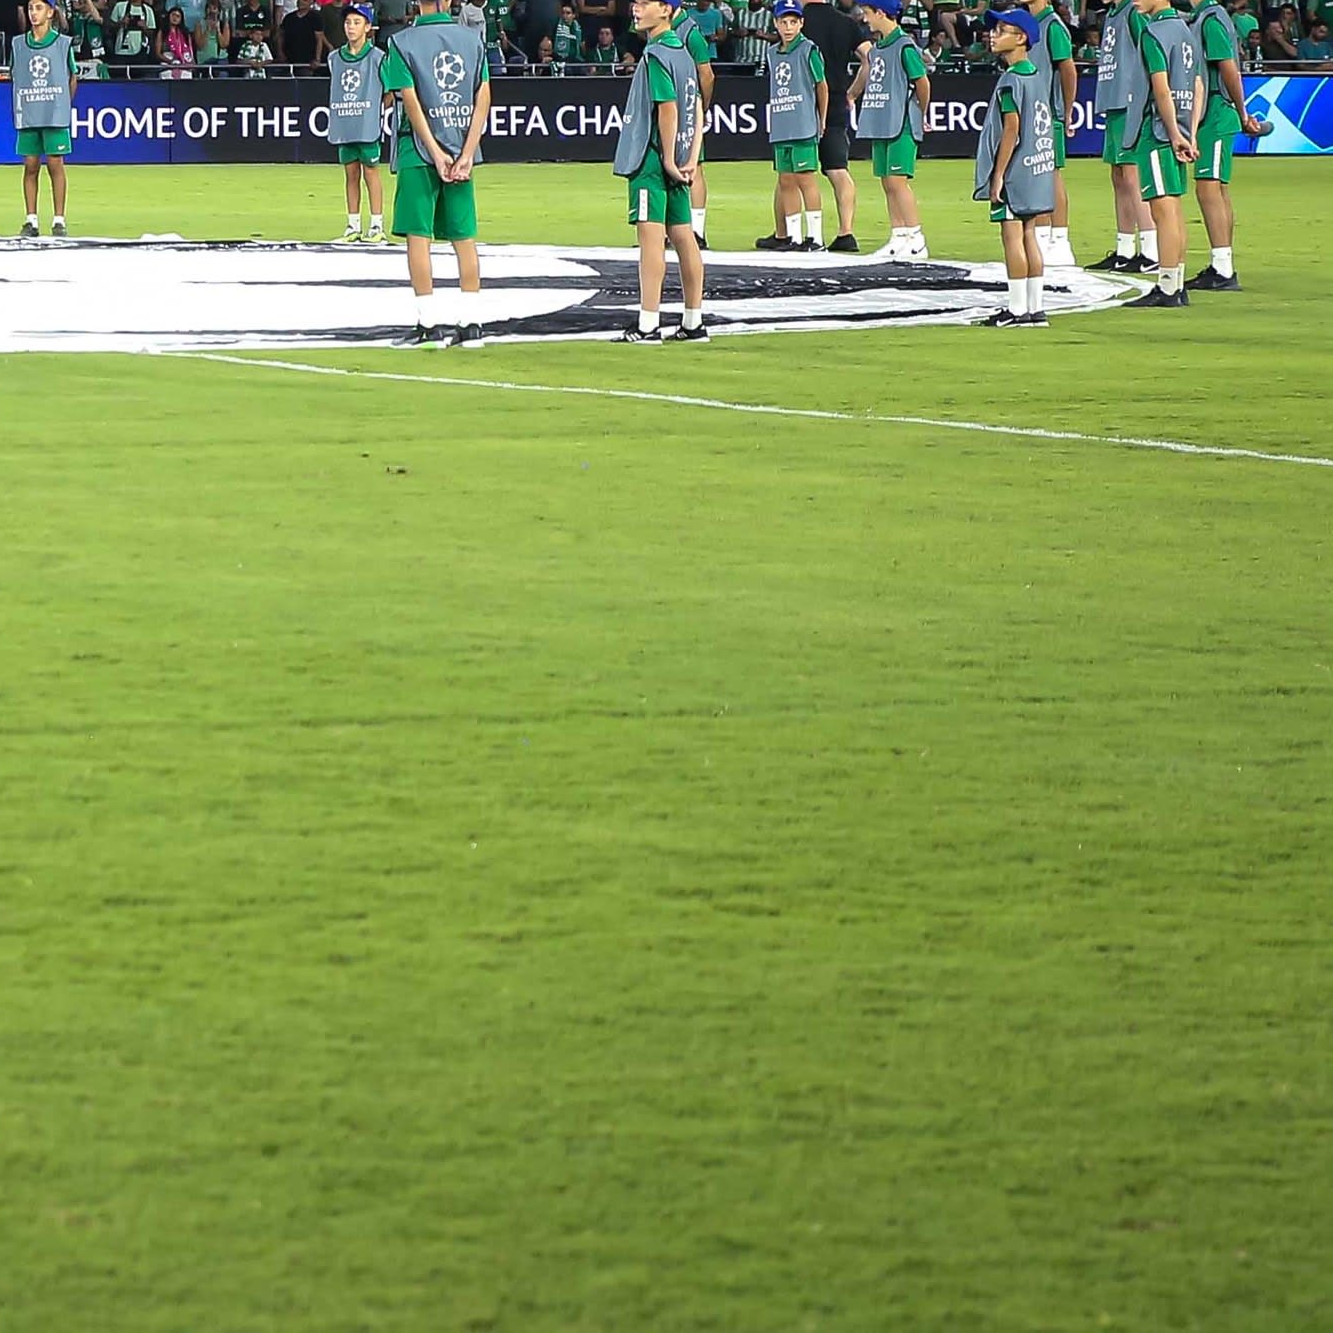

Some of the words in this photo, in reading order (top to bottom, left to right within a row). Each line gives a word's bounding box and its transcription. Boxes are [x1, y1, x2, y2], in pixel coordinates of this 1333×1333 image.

[71, 107, 176, 138] HOME
[183, 107, 228, 138] OF
[234, 106, 301, 138] THE
[481, 105, 549, 136] EFA
